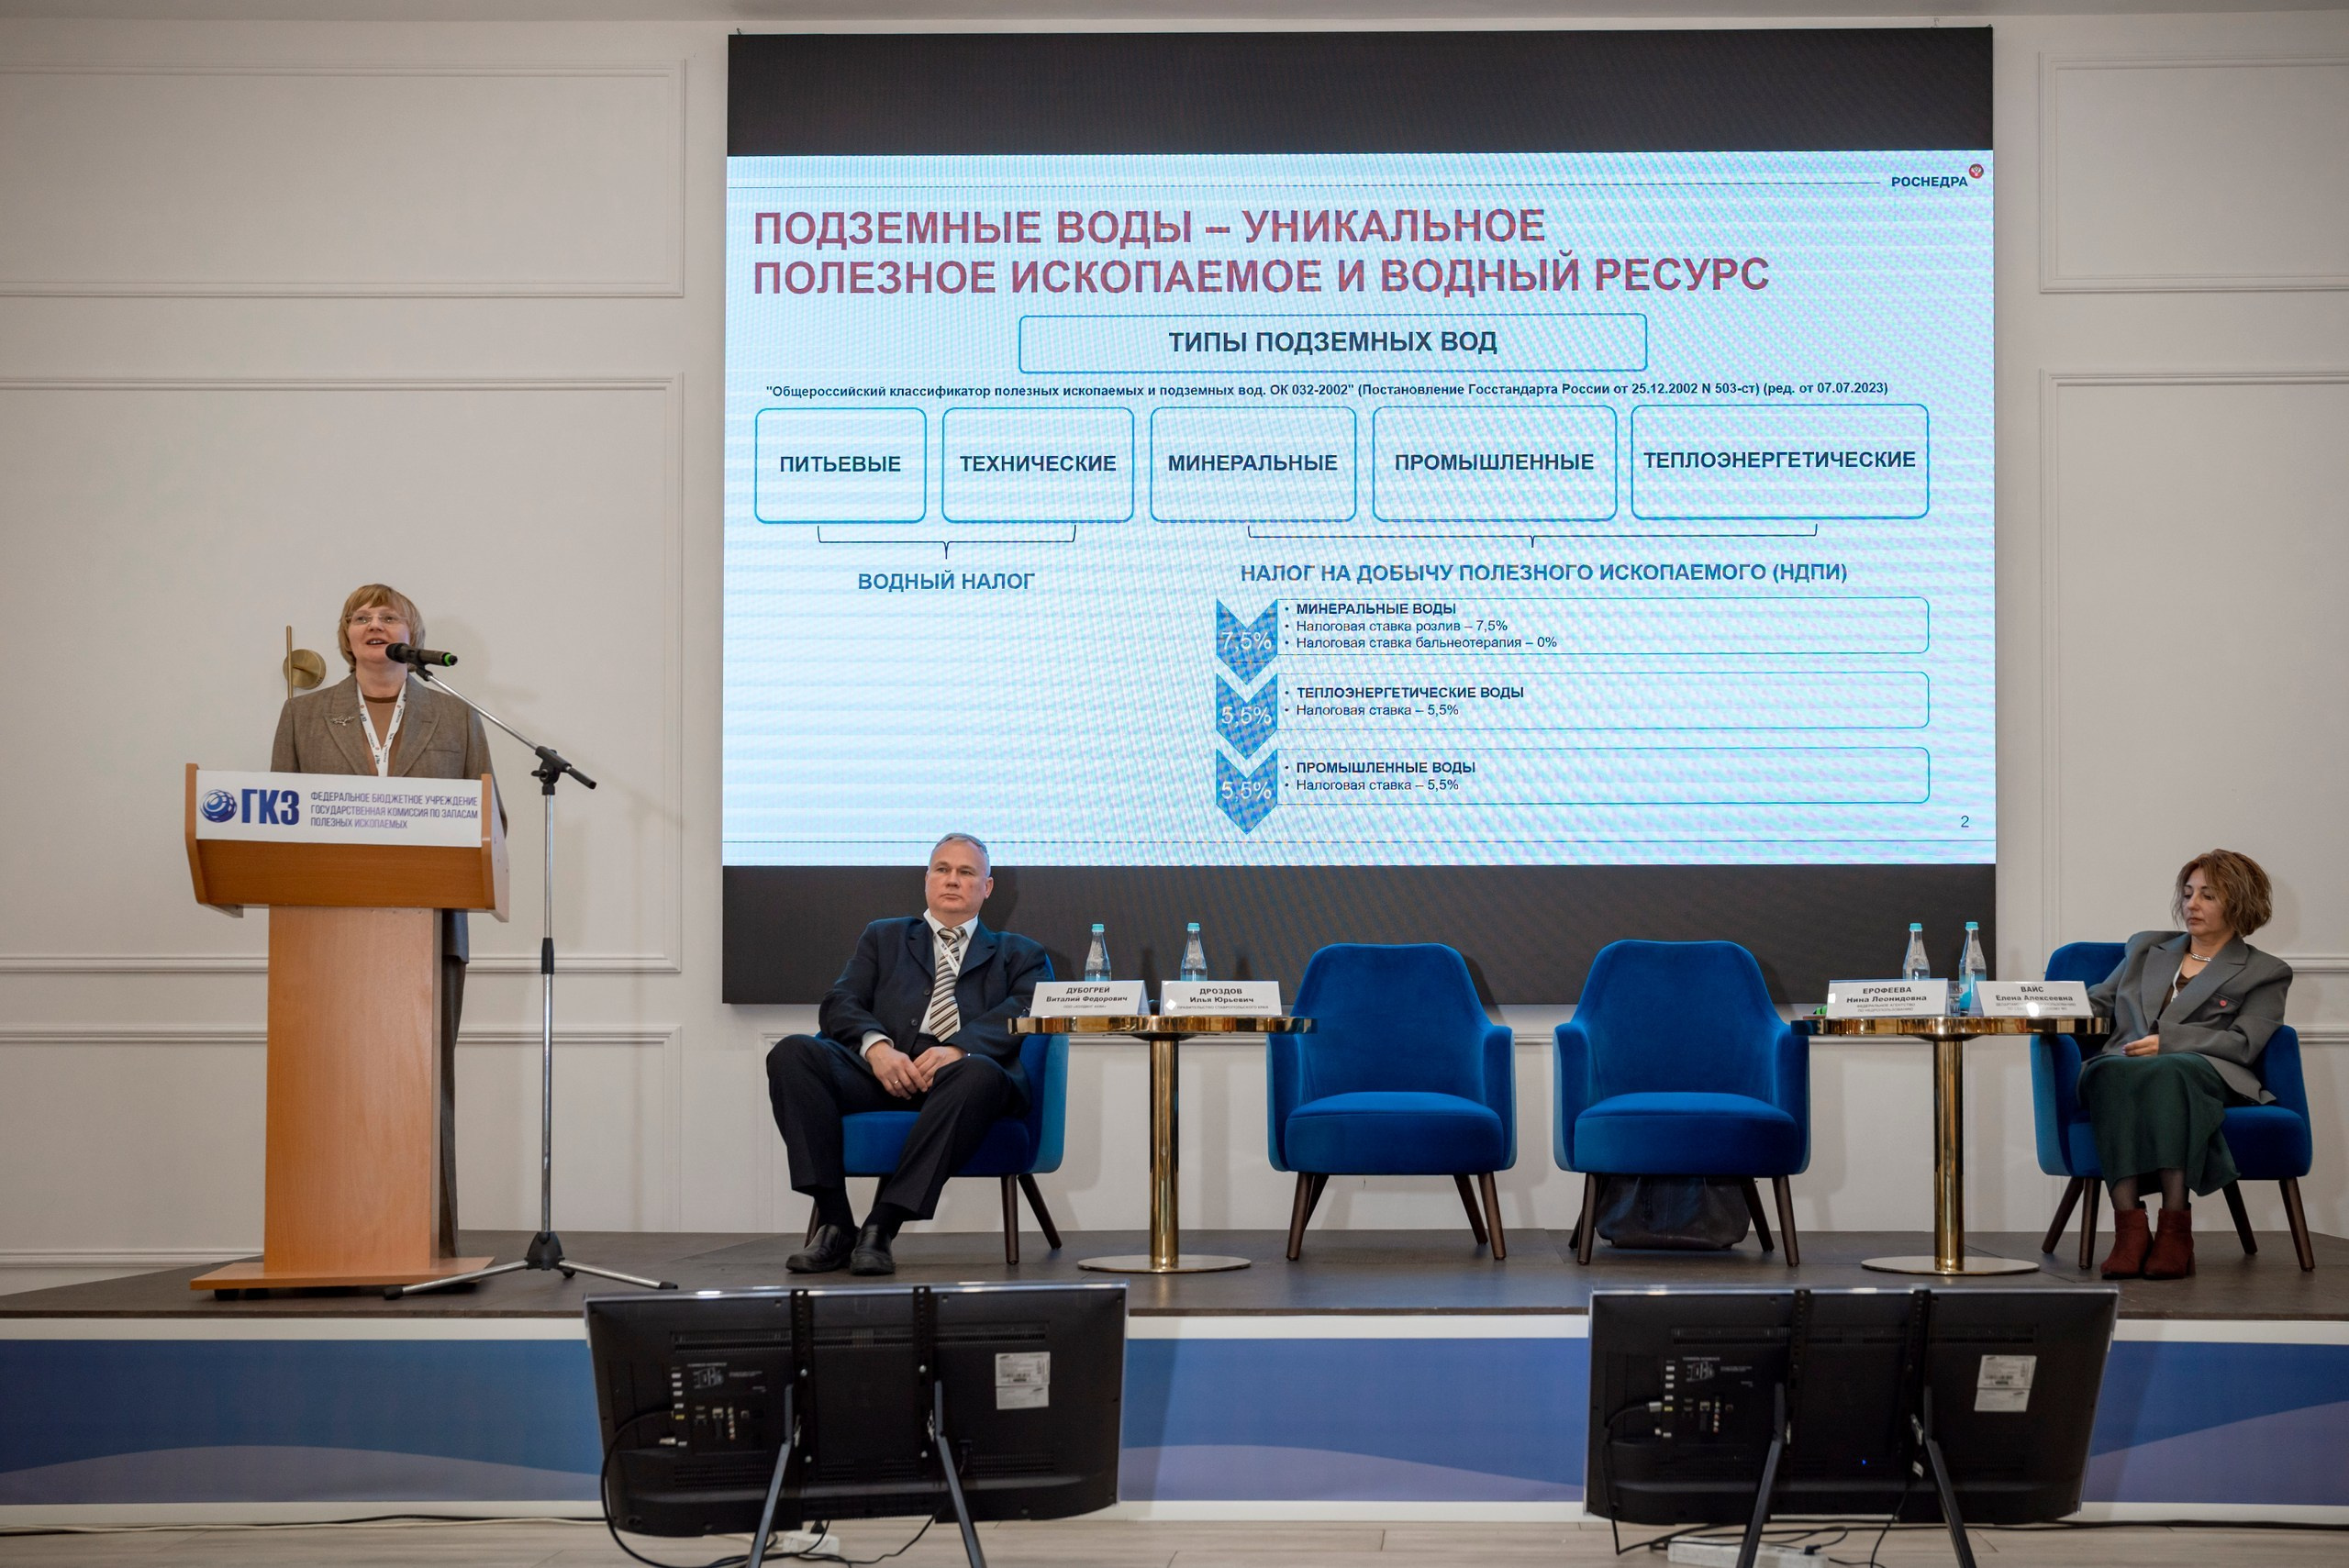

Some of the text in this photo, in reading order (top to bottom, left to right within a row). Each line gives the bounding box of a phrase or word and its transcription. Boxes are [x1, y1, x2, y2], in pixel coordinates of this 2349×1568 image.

[1891, 176, 1968, 188] РОСНЕДРА
[754, 211, 1042, 250] ПОДЗЕМНЫЕ
[1057, 209, 1191, 249] ВОДЫ
[1243, 208, 1545, 244] УНИКАЛЬНОЕ
[754, 249, 1771, 297] ПОЛЕЗНОЕ ИСКОПАЕМОЕ И ВОДНЫЙ РЕСУРС
[1169, 331, 1497, 356] ТИПЫ ПОДЗЕМНЫХ ВОД
[766, 382, 1888, 398] "Общероссийский классификатор полезных ископаемых и подземных вод. ОК 032-2002" (Постановление Госстандарта России от 25.12.2002 N 503-ст) (ред. от 07.07.2023)
[780, 454, 901, 473] ПИТЬЕВЫЕ
[960, 454, 1117, 473] ТЕХНИЧЕСКИЕ
[1168, 454, 1338, 472] МИНЕРАЛЬНЫЕ
[1395, 452, 1594, 471] ПРОМЫШЛЕННЫЕ
[1643, 450, 1916, 469] ТЕПЛОЭНЕРГЕТИЧЕСКИЕ
[858, 568, 1035, 593] ВОДНЫЙ НАЛОГ
[1241, 562, 1848, 586] НАЛОГ НА ДОБЫЧУ ПОЛЕЗНОГО ИСКОПАЕМОГО (НДПИ)
[1297, 603, 1456, 617] МИНЕРАЛЬНЫЕ ВОДЫ
[1297, 620, 1365, 632] Налоговая
[1369, 623, 1411, 631] ставка
[1416, 622, 1461, 634] розлив
[1475, 620, 1508, 633] 7,5%
[1221, 631, 1272, 651] 7,5%
[1297, 637, 1365, 649] Налоговая
[1369, 639, 1411, 649] ставка
[1416, 636, 1522, 651] бальнеотерапия
[1537, 636, 1557, 648] 0%
[1297, 686, 1524, 700] ТЕПЛОЭНЕРГЕТИЧЕСКИЕ ВОДЫ
[1221, 706, 1272, 728] 5,5%
[1297, 704, 1365, 717] Налоговая
[1369, 706, 1411, 716] ставка
[1427, 704, 1459, 717] 5,5%
[1297, 762, 1475, 775] ПРОМЫШЛЕННЫЕ ВОДЫ
[1221, 780, 1272, 801] 5,5%
[1297, 779, 1365, 792] Налоговая
[1369, 782, 1411, 791] ставка
[1427, 779, 1459, 793] 5,5%
[241, 788, 299, 826] ГКЗ
[310, 792, 478, 806] ФЕДЕРАЛЬНОЕ БЮДЖЕТНОЕ УЧРЕЖДЕНИЕ
[310, 805, 478, 818] ГОСУДАРСТВЕННАЯ КОМИССИЯ ПО ЗАПАСАМ
[310, 817, 407, 828] ПОЛЕЗНЫХ ИСКОПАЕМЫХ
[1960, 814, 1970, 828] 2
[1066, 986, 1110, 995] ДУБОГРЕЙ
[1863, 986, 1912, 995] ЕРОФЕЕВА
